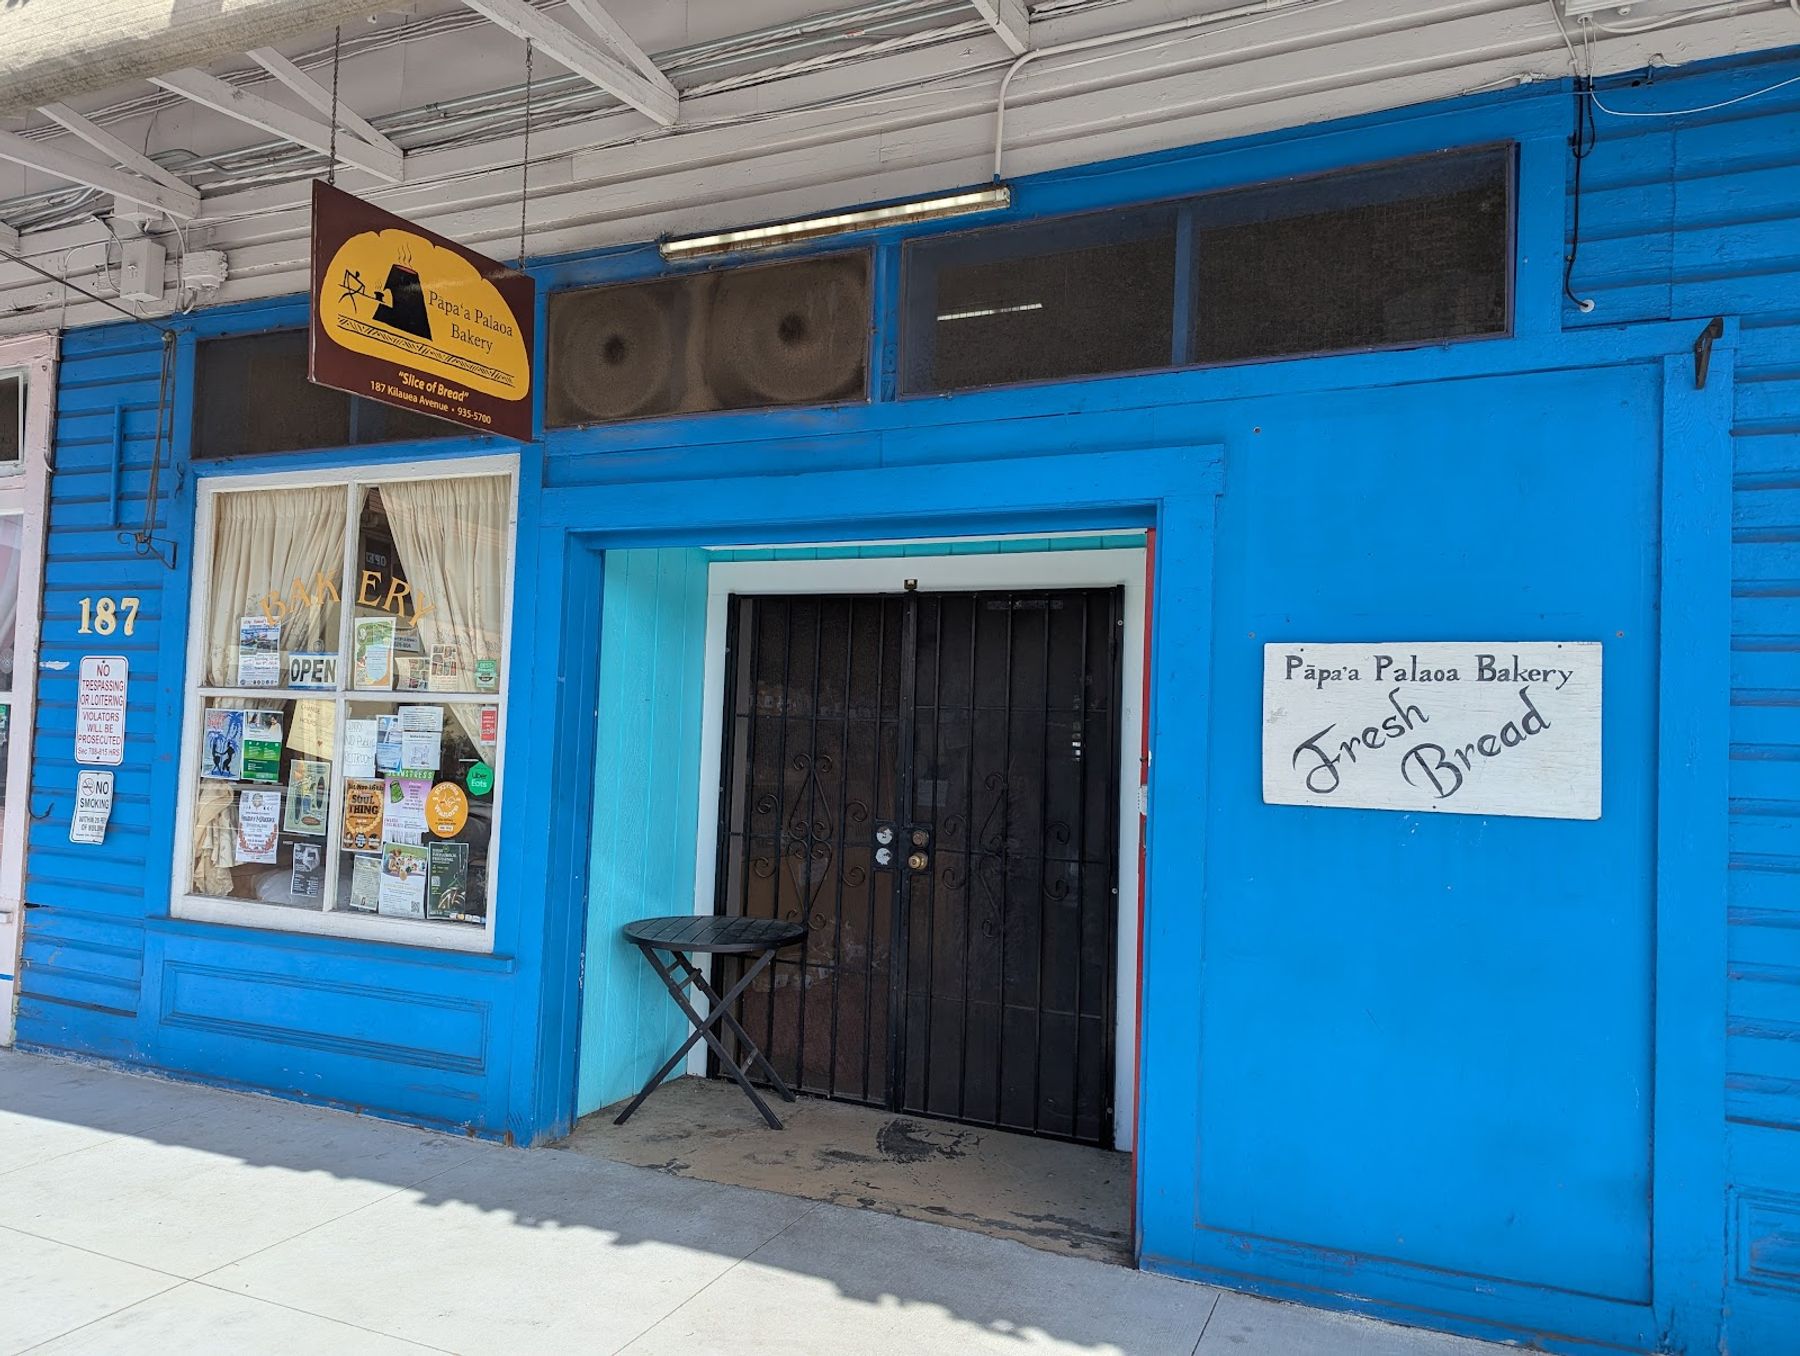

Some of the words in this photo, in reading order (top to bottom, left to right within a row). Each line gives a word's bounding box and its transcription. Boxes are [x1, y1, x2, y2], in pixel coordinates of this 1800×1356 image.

[474, 308, 513, 337] Palaoa
[451, 323, 493, 354] Bakery
[426, 381, 437, 394] of
[370, 381, 386, 393] 187
[387, 385, 418, 403] Kilauea
[419, 395, 449, 412] Avenue
[456, 407, 492, 424] 935-5700
[260, 568, 436, 627] BAKERY
[78, 597, 140, 636] 187
[96, 664, 111, 677] NO
[290, 658, 337, 683] OPEN
[1374, 654, 1461, 683] Palaoa
[1475, 654, 1575, 690] Bakery
[82, 679, 124, 692] TRESPASSING
[80, 694, 89, 706] OR
[91, 695, 124, 706] LOITERING
[82, 711, 120, 722] VIOLATORS
[86, 723, 103, 733] WILL
[104, 724, 114, 733] BE
[78, 734, 122, 745] PROSECUTED
[1292, 687, 1430, 794] Fresh
[1400, 685, 1552, 799] Bread
[472, 771, 488, 779] Uber
[95, 781, 109, 795] NO
[471, 778, 487, 787] Eats
[79, 797, 110, 809] SMOKING
